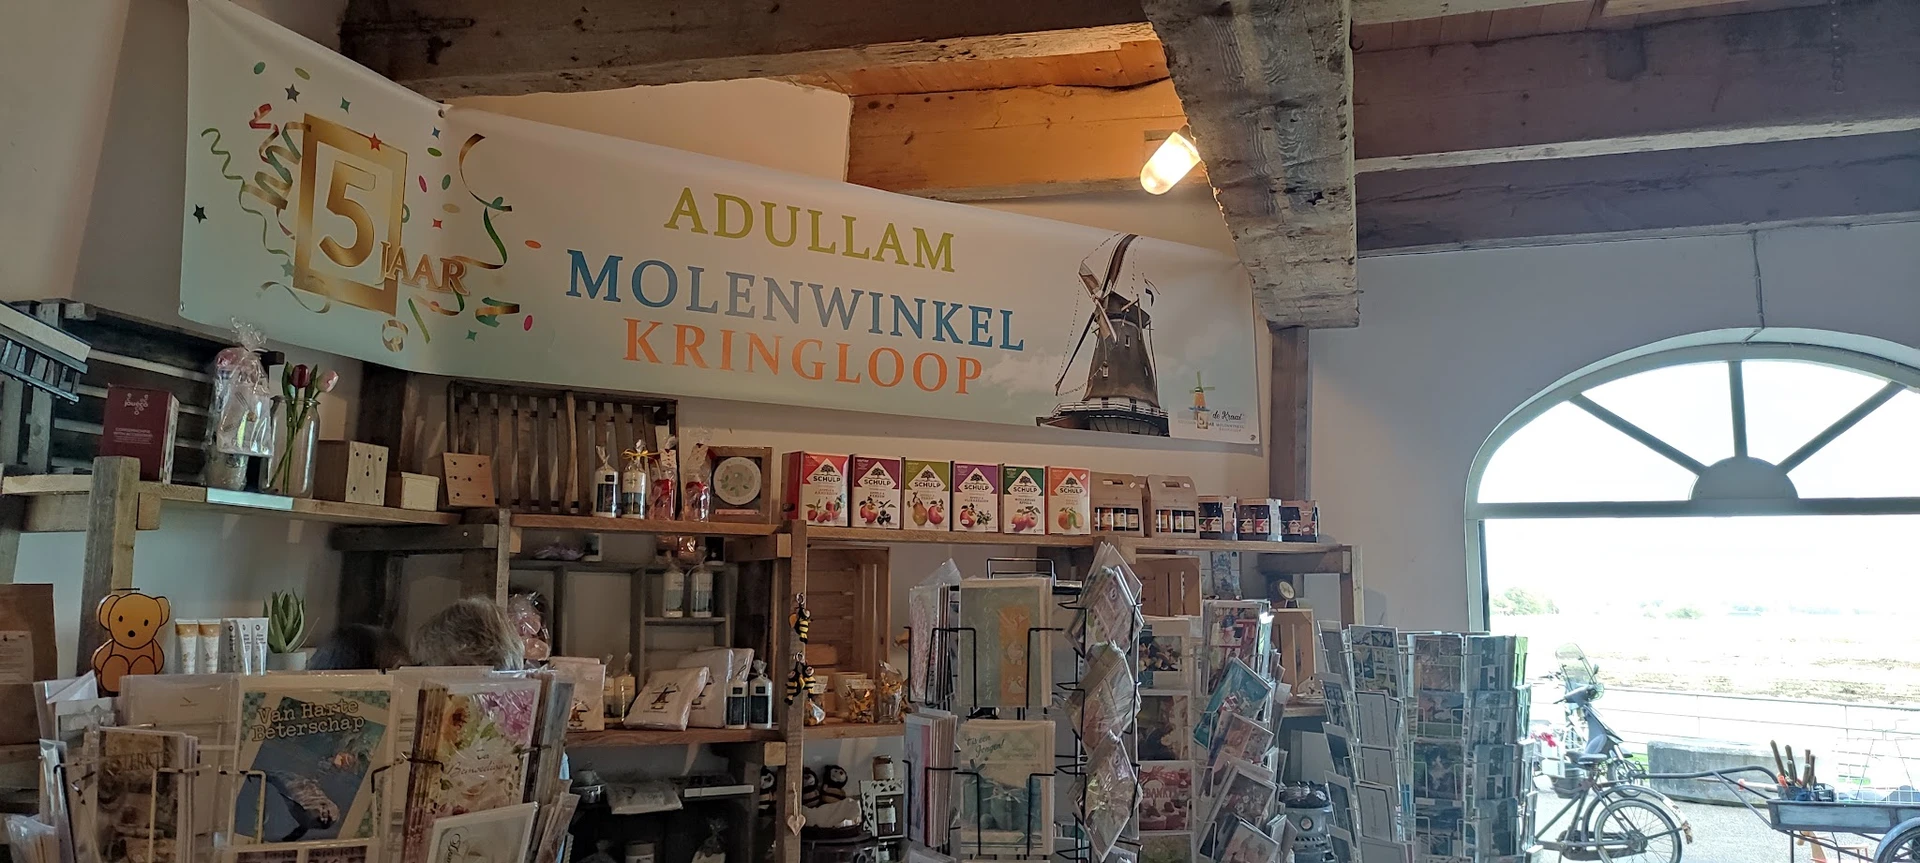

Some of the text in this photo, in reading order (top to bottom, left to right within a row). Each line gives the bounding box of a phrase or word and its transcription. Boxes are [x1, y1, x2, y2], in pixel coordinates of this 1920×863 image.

[319, 160, 376, 268] 5
[664, 187, 955, 273] ADULLAM
[375, 241, 470, 296] JAAR
[566, 249, 1025, 351] MOLENWINKEL
[623, 318, 982, 395] KRINGLOOP
[251, 715, 365, 741] Beterschap
[258, 699, 359, 725] Van Harte
